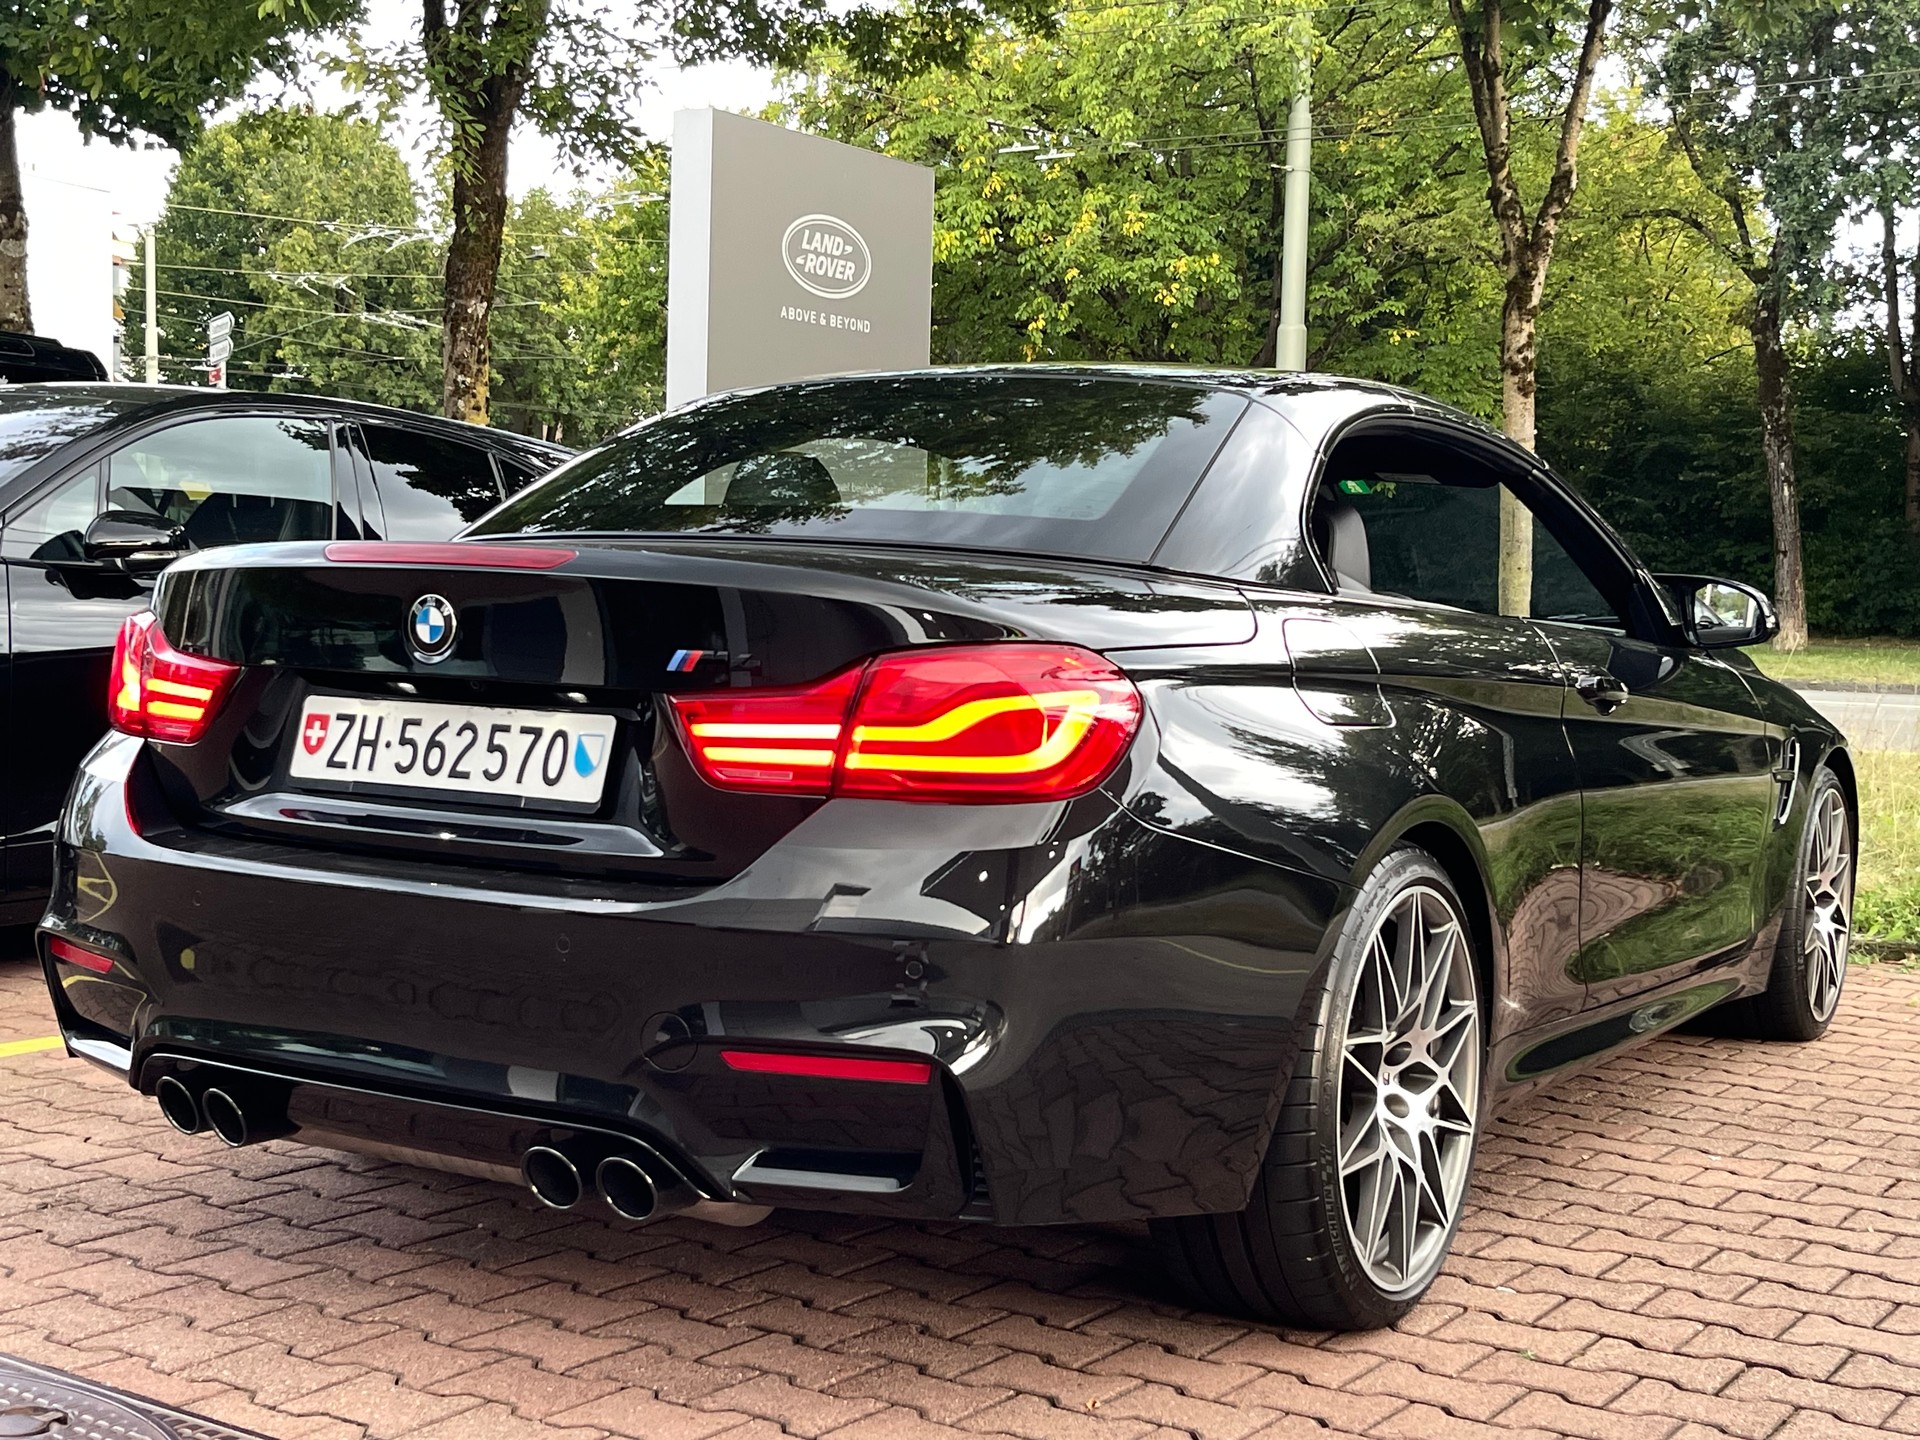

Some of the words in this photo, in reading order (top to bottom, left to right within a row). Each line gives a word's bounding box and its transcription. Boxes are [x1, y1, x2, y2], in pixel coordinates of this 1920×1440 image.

[801, 229, 844, 256] LAND
[804, 253, 856, 281] ROVER
[780, 305, 817, 324] ABOVE
[819, 312, 828, 326] &
[829, 314, 871, 333] BEYOND
